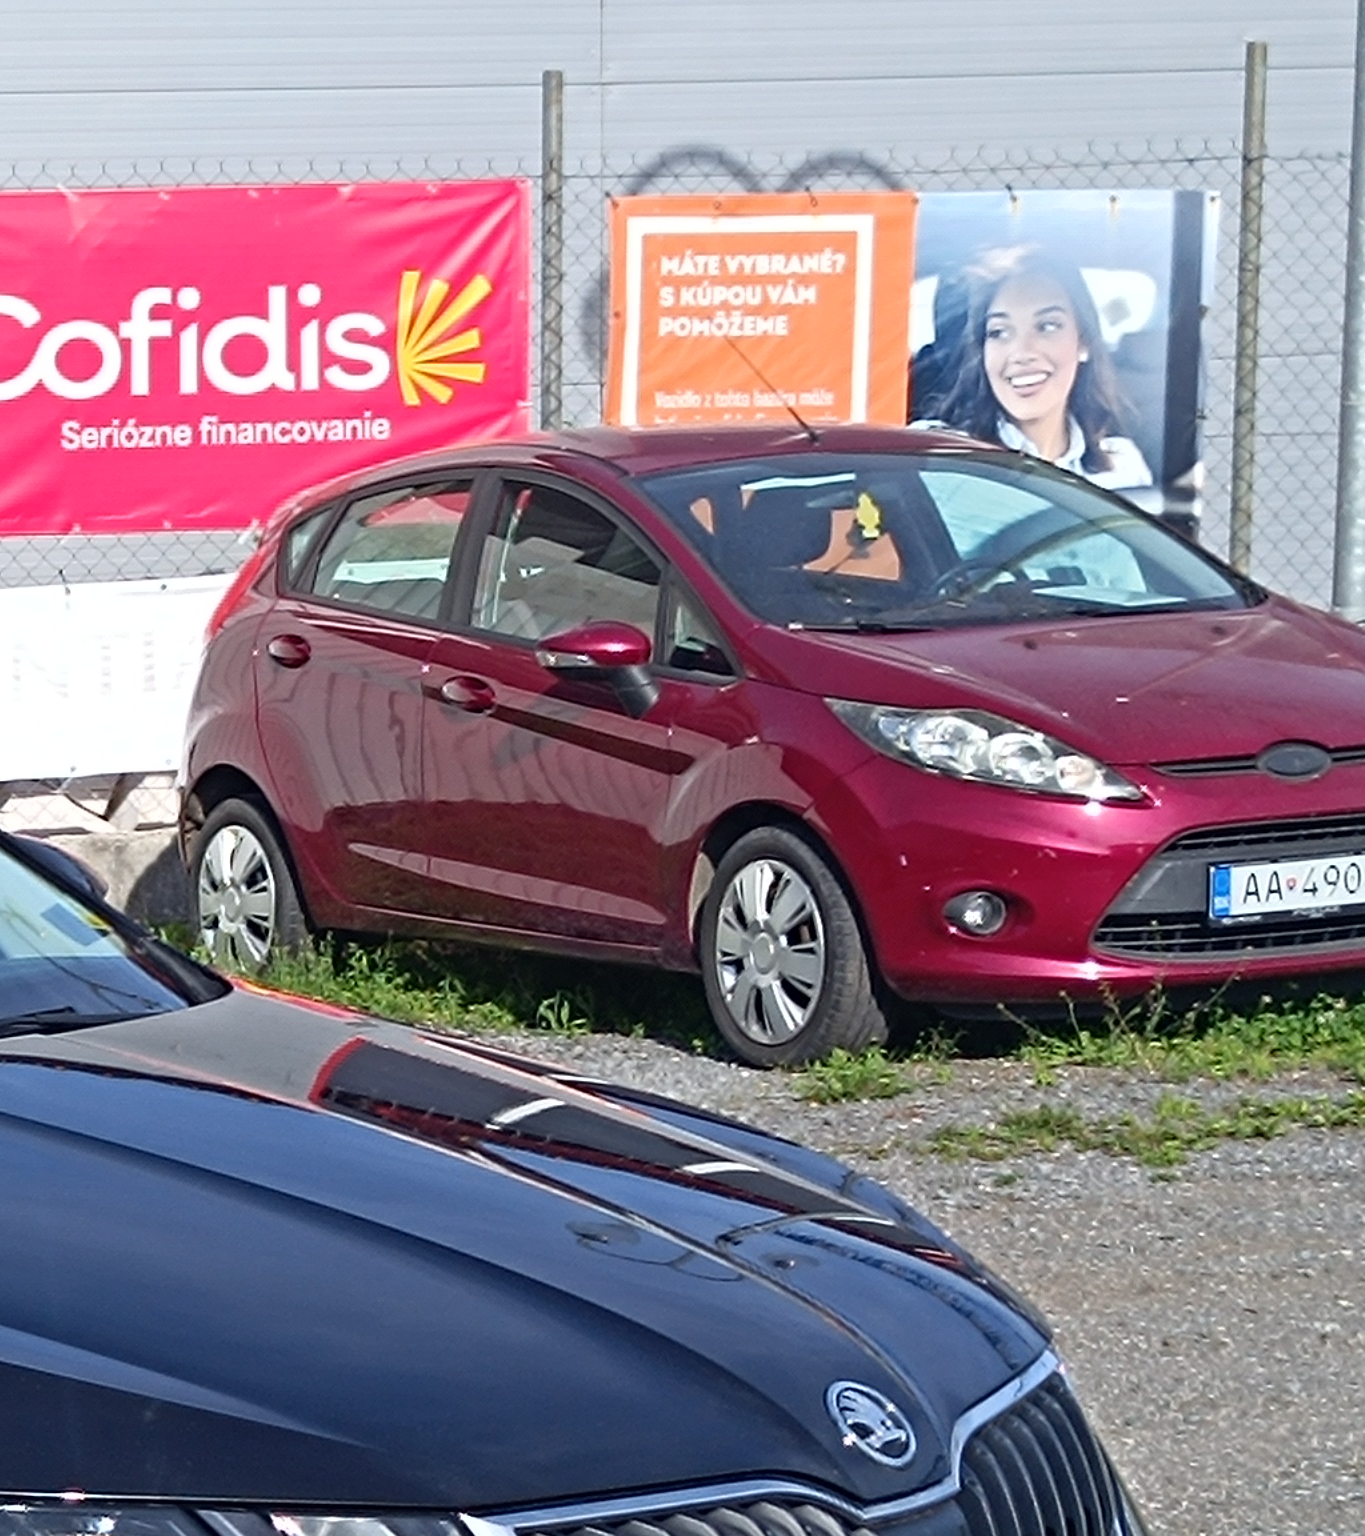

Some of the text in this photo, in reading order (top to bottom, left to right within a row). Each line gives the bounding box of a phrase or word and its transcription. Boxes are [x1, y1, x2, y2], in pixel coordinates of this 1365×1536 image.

[660, 247, 846, 275] MÁTE VYBRANÉ?
[659, 279, 817, 307] S KÚPOU VÁM
[658, 310, 789, 336] POMÔŽEME
[61, 411, 391, 451] Seriózne financovanie
[1242, 861, 1362, 904] AA 490
